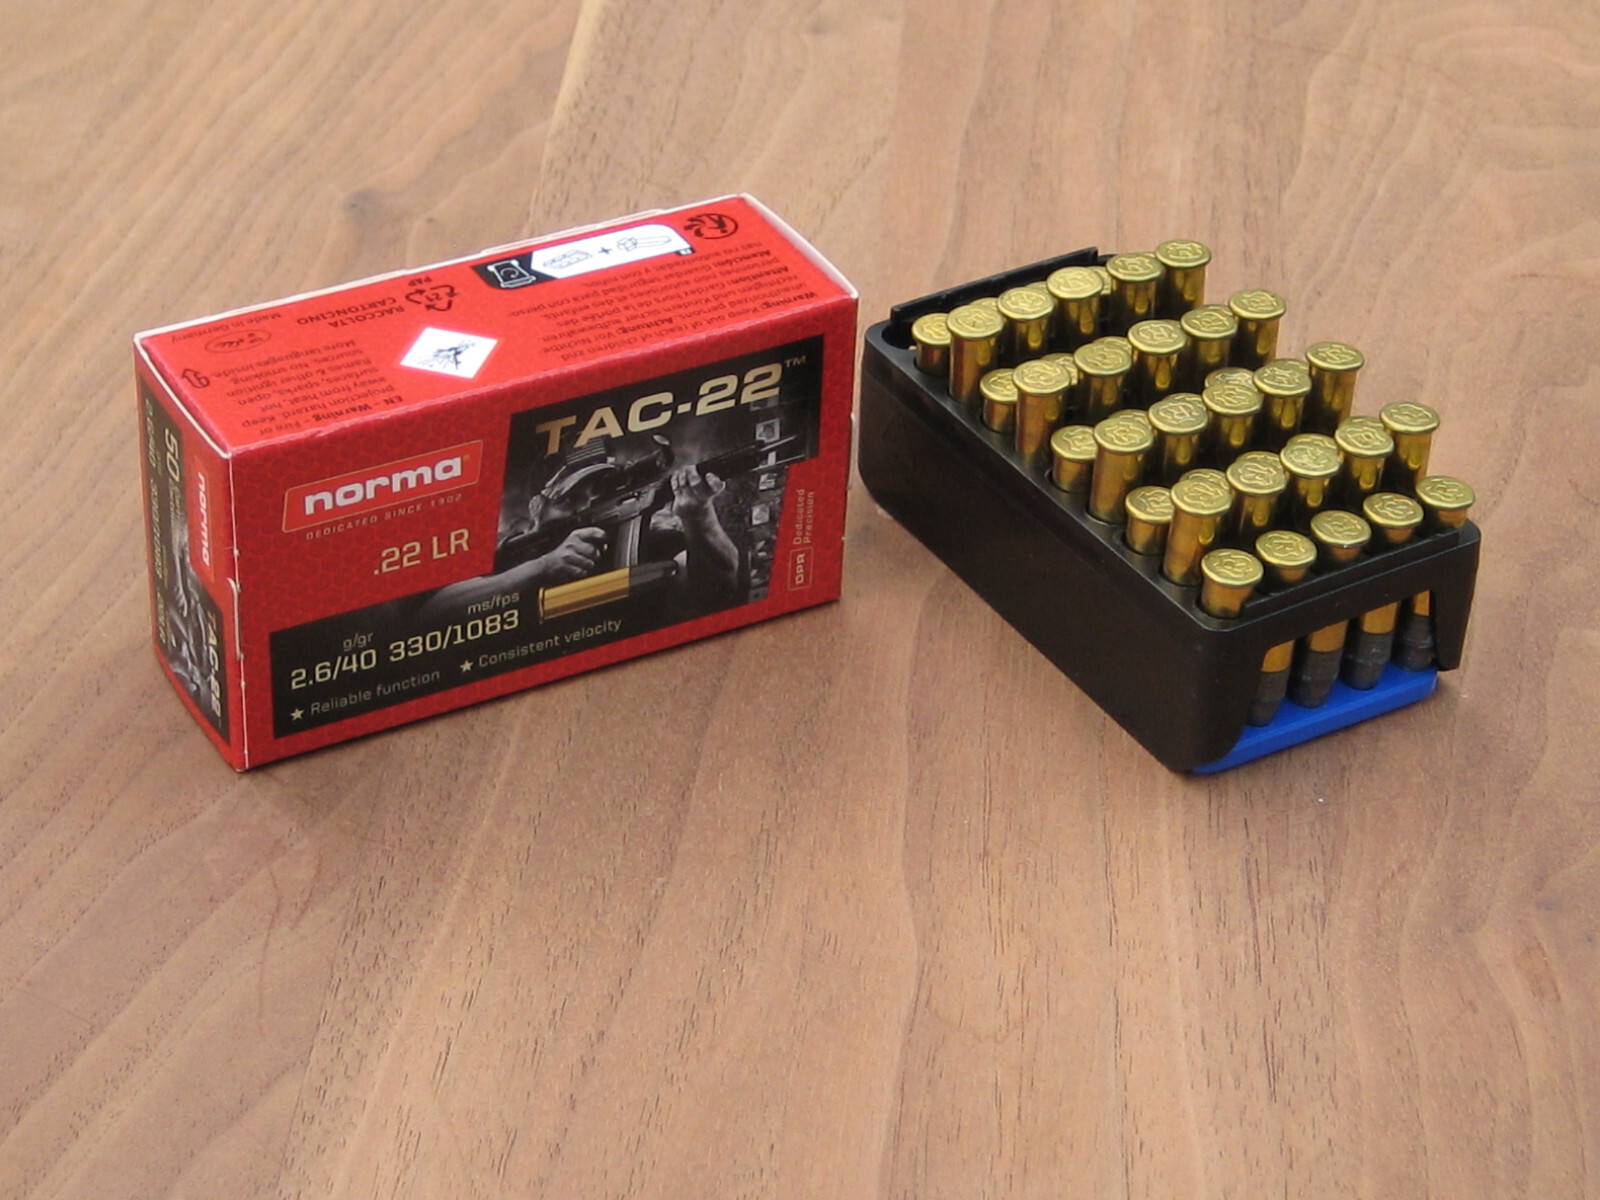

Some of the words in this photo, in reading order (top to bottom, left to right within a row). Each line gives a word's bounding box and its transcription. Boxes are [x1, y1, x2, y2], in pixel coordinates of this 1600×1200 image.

[403, 275, 433, 286] PAP
[293, 295, 398, 325] CARTONCINO
[326, 304, 406, 328] RACCOLTA
[165, 427, 180, 483] 50
[304, 454, 461, 517] norma
[197, 471, 210, 567] norma
[305, 513, 378, 541] DEDICATED
[384, 502, 422, 521] SINCE
[792, 488, 804, 546] Dedicated
[803, 491, 814, 544] Precision
[373, 539, 420, 576] .22
[432, 526, 469, 560] LR
[795, 553, 806, 586] DPR
[467, 589, 520, 617] ms/fps
[290, 646, 377, 692] 2.6/40
[388, 606, 519, 665] 330/1083
[342, 628, 374, 652] g/gr
[478, 633, 559, 668] Consistent
[564, 616, 622, 646] velocity
[310, 685, 372, 716] Reliable
[376, 666, 440, 698] function
